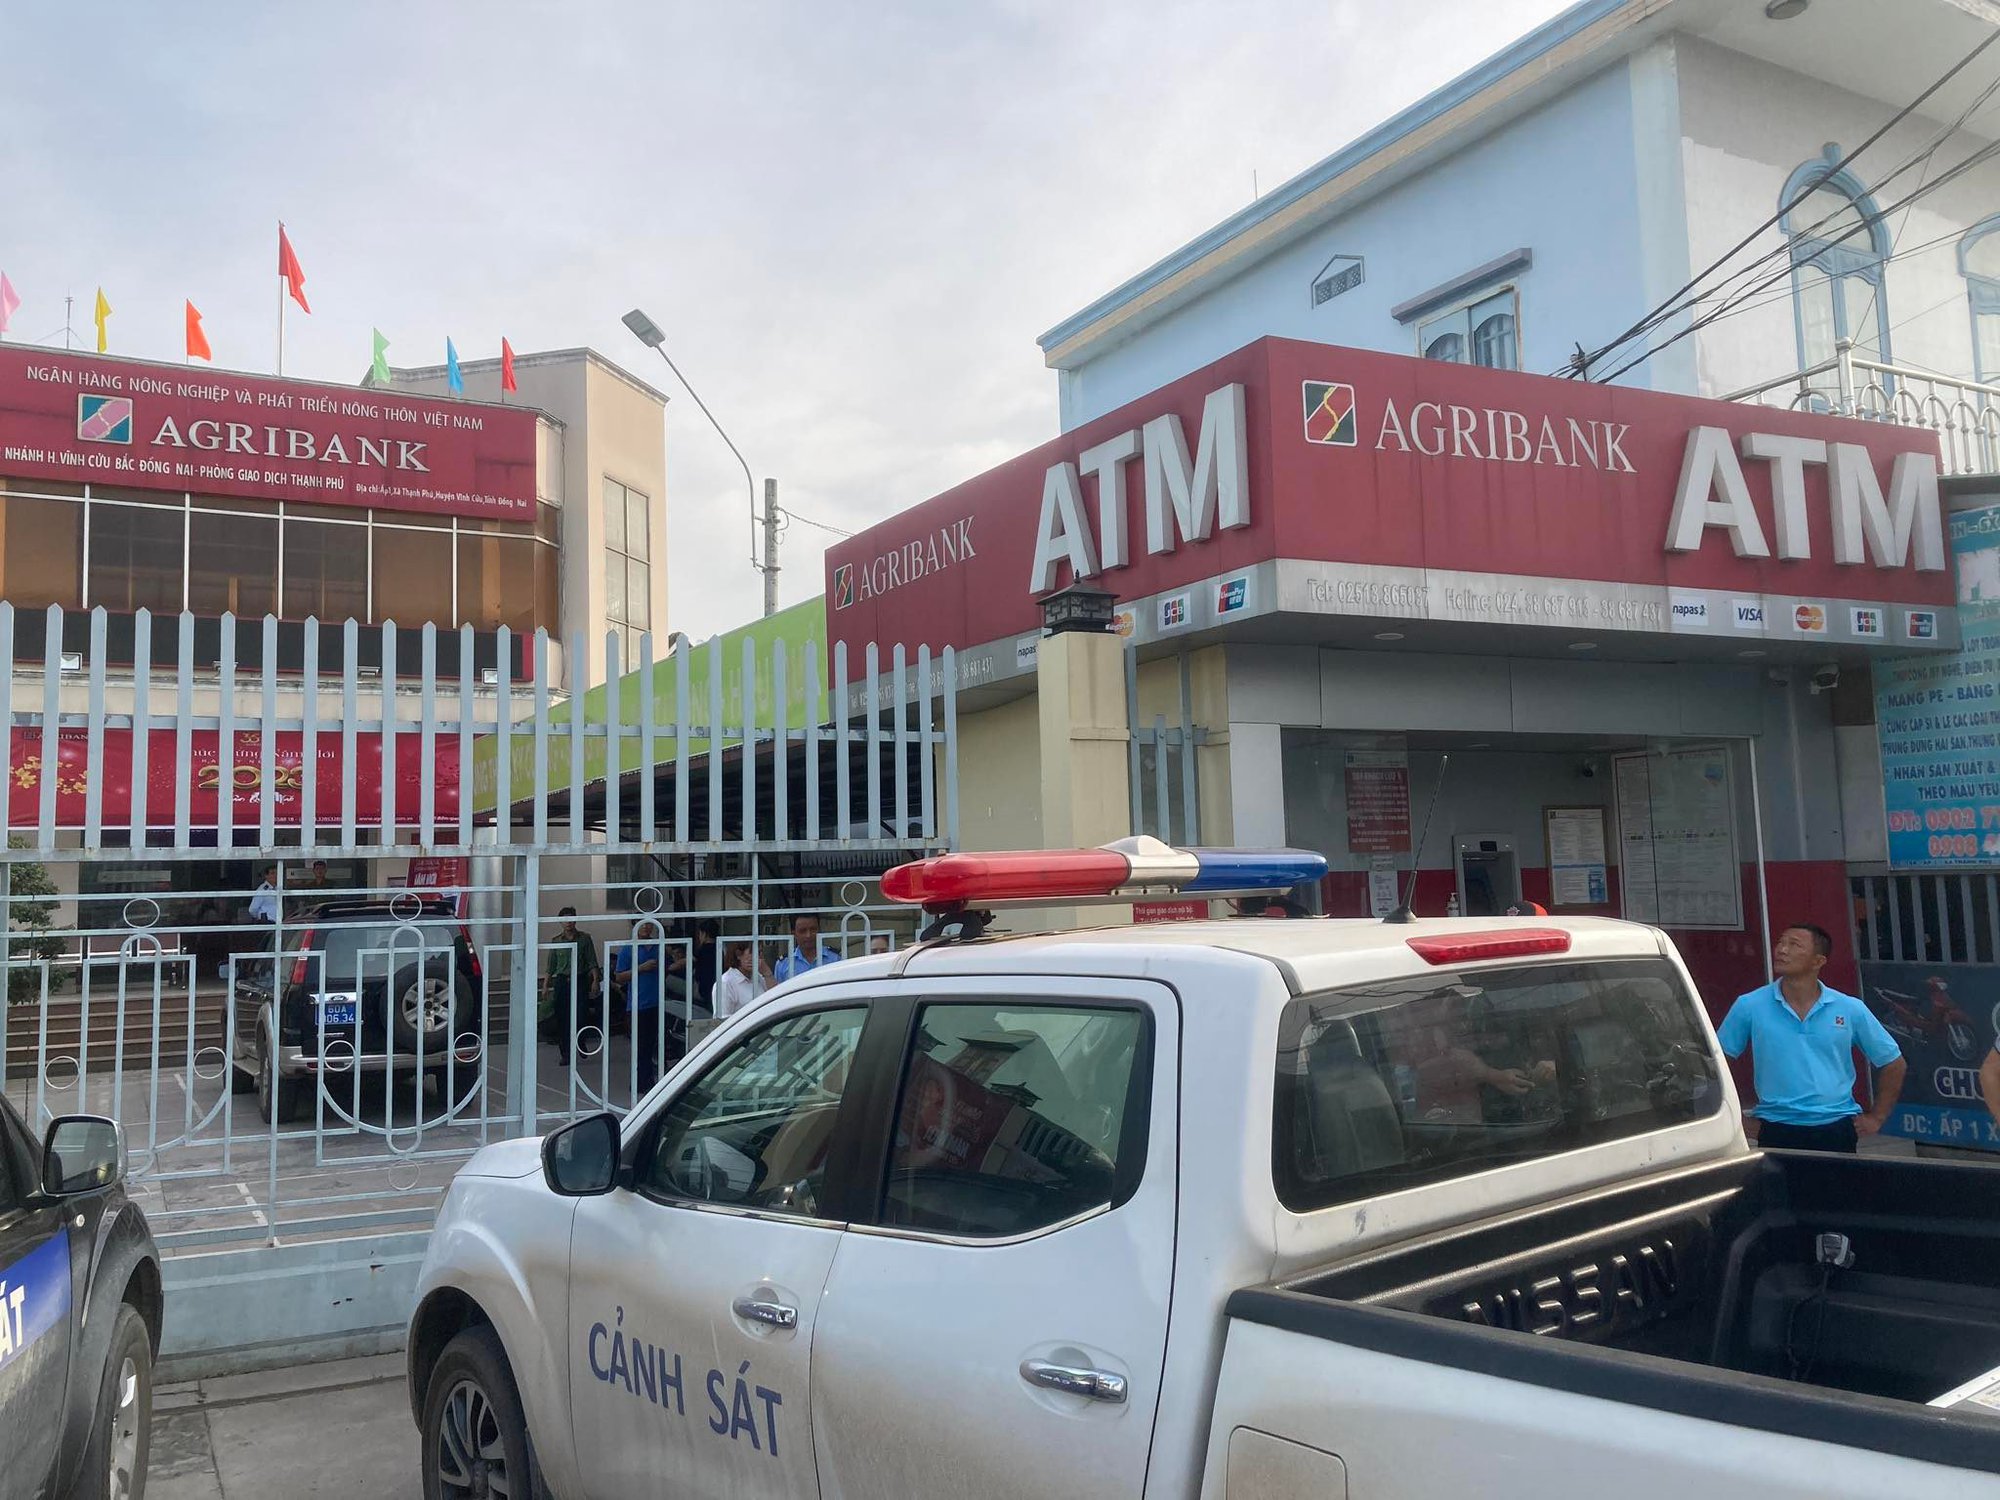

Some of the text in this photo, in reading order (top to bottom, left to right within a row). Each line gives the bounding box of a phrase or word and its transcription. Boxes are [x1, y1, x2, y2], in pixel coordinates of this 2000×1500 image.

[27, 365, 483, 430] NGÂN HÀNG NÔNG NGHIỆP VÀ PHÁT TRIỂN NÔNG THÔN VIỆT NAM
[5, 445, 43, 462] NHÁNH
[115, 453, 134, 471] BẮC
[139, 457, 170, 474] ĐỒNG
[238, 468, 260, 482] GIAO
[264, 471, 287, 486] DỊCH
[291, 474, 323, 488] THẠNH
[150, 415, 431, 472] AGRIBANK
[1374, 397, 1637, 474] AGRIBANK
[1029, 382, 1251, 595] ATM
[1664, 426, 1946, 572] ATM
[858, 514, 977, 603] AGRIBANK
[1738, 608, 1763, 622] VISA
[198, 765, 303, 790] 2023
[326, 1013, 355, 1024] 06.34
[589, 1305, 783, 1457] CẢNH SÁT
